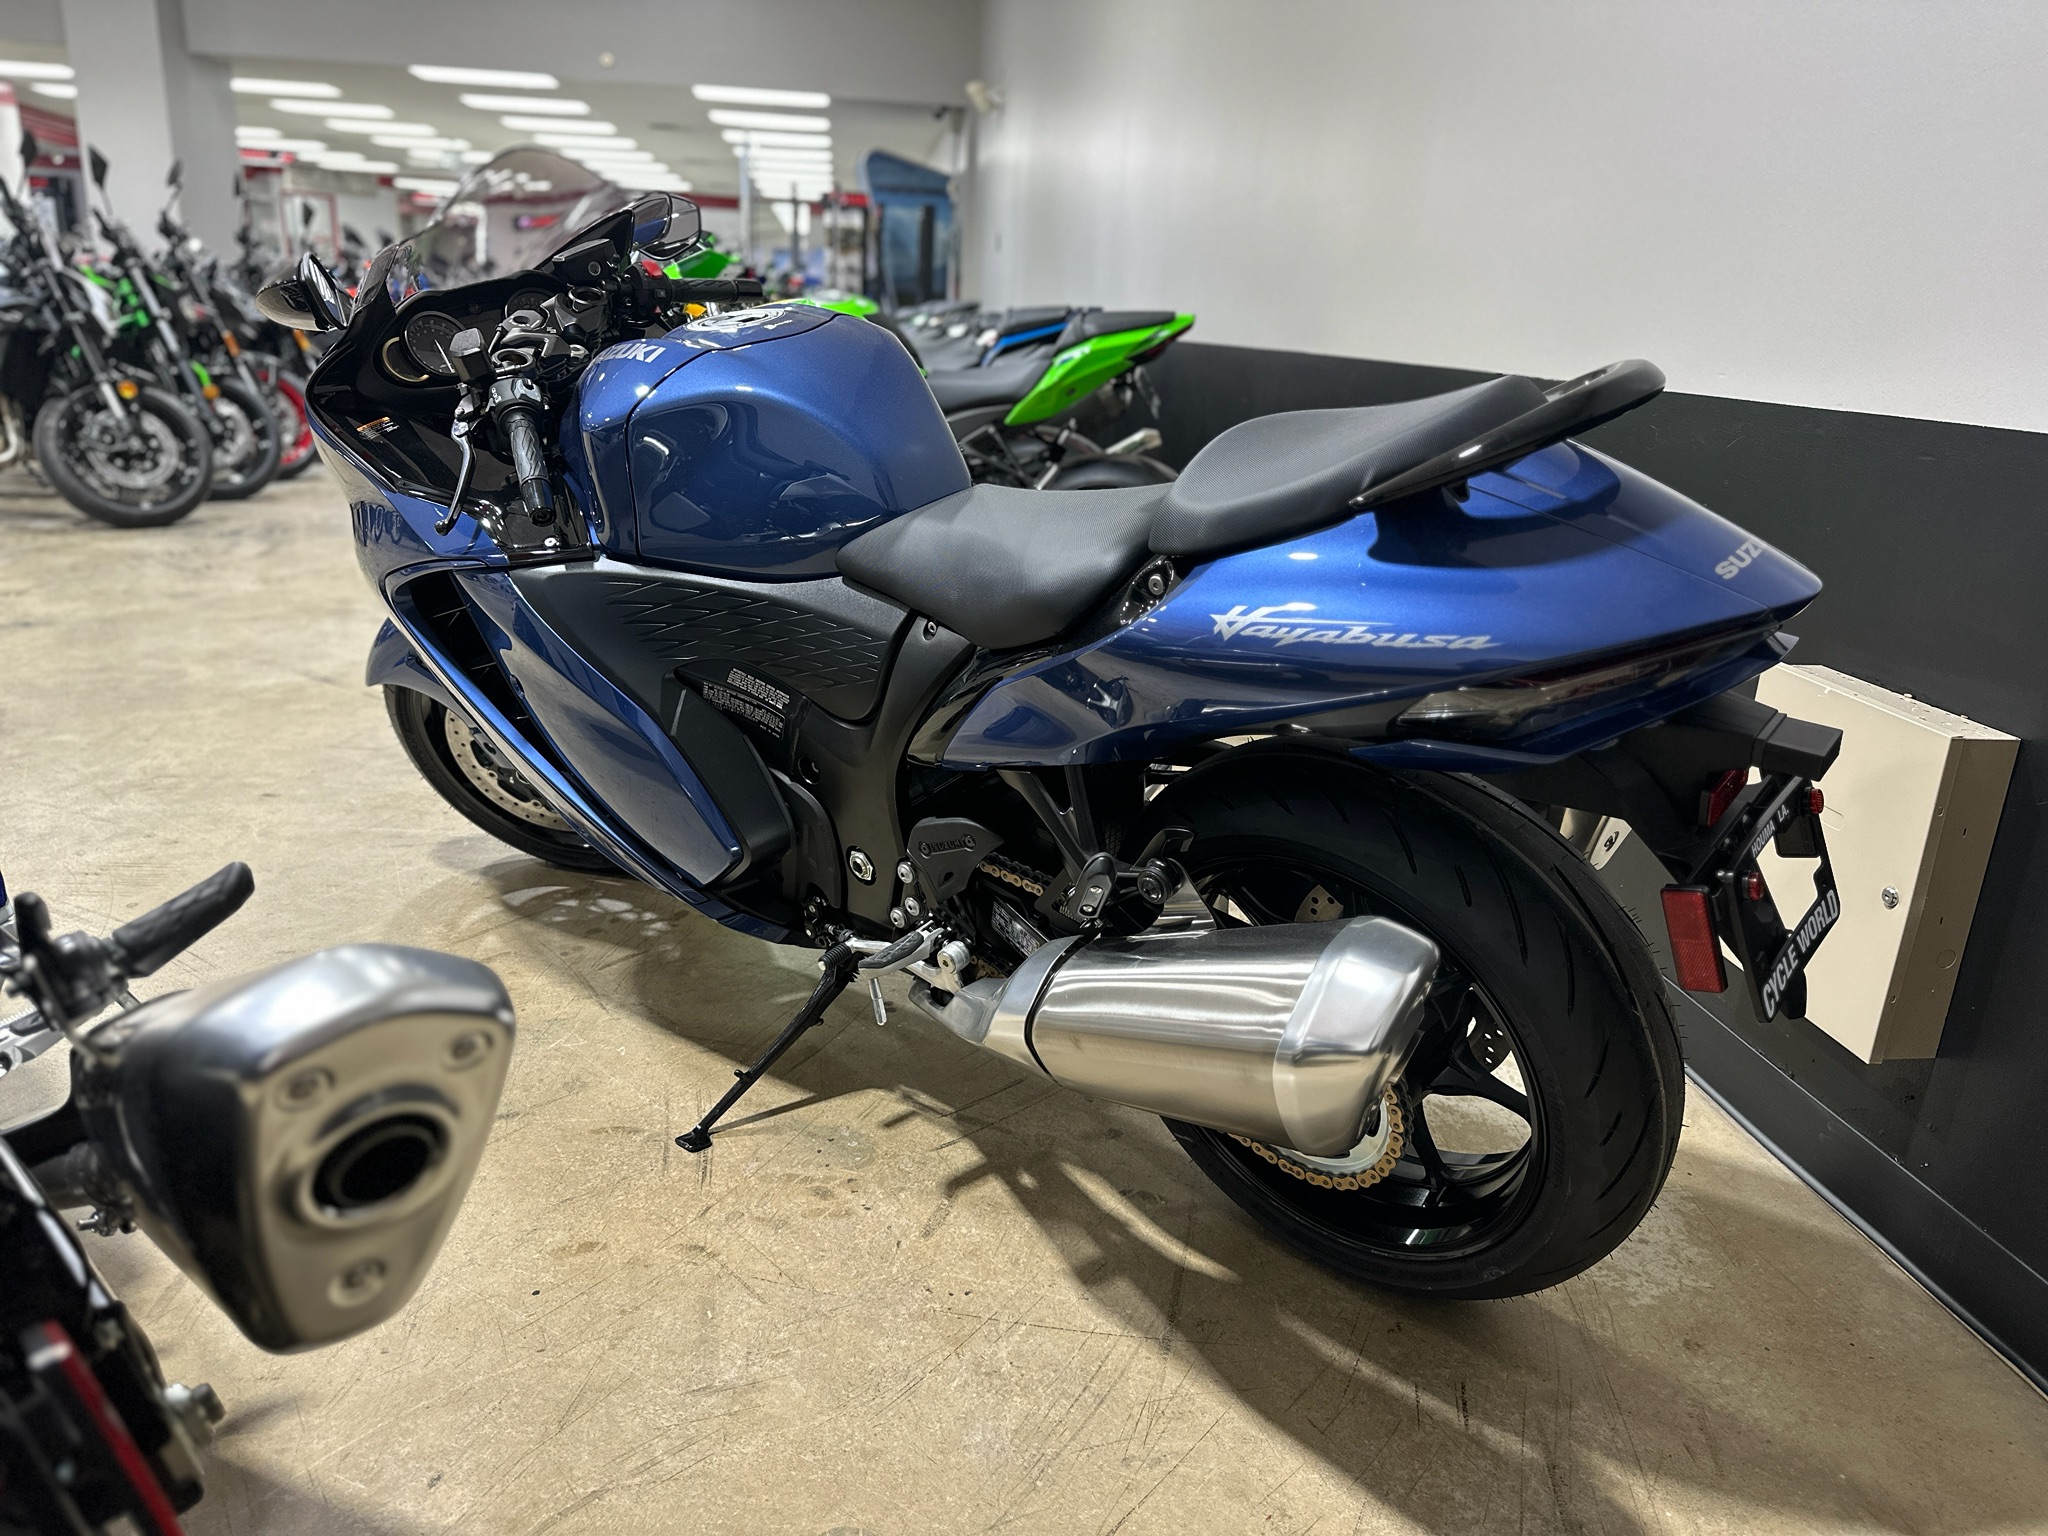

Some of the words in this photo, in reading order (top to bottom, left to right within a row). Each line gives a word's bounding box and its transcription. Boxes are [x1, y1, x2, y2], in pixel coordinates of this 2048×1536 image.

[1714, 540, 1765, 580] SUZ
[1210, 602, 1504, 650] Hayabusa
[931, 840, 964, 852] SUZUKI
[1751, 820, 1775, 858] HOUMA
[1777, 804, 1789, 823] LA.
[1763, 943, 1799, 1019] CYCLE
[1796, 889, 1839, 953] WORLD
